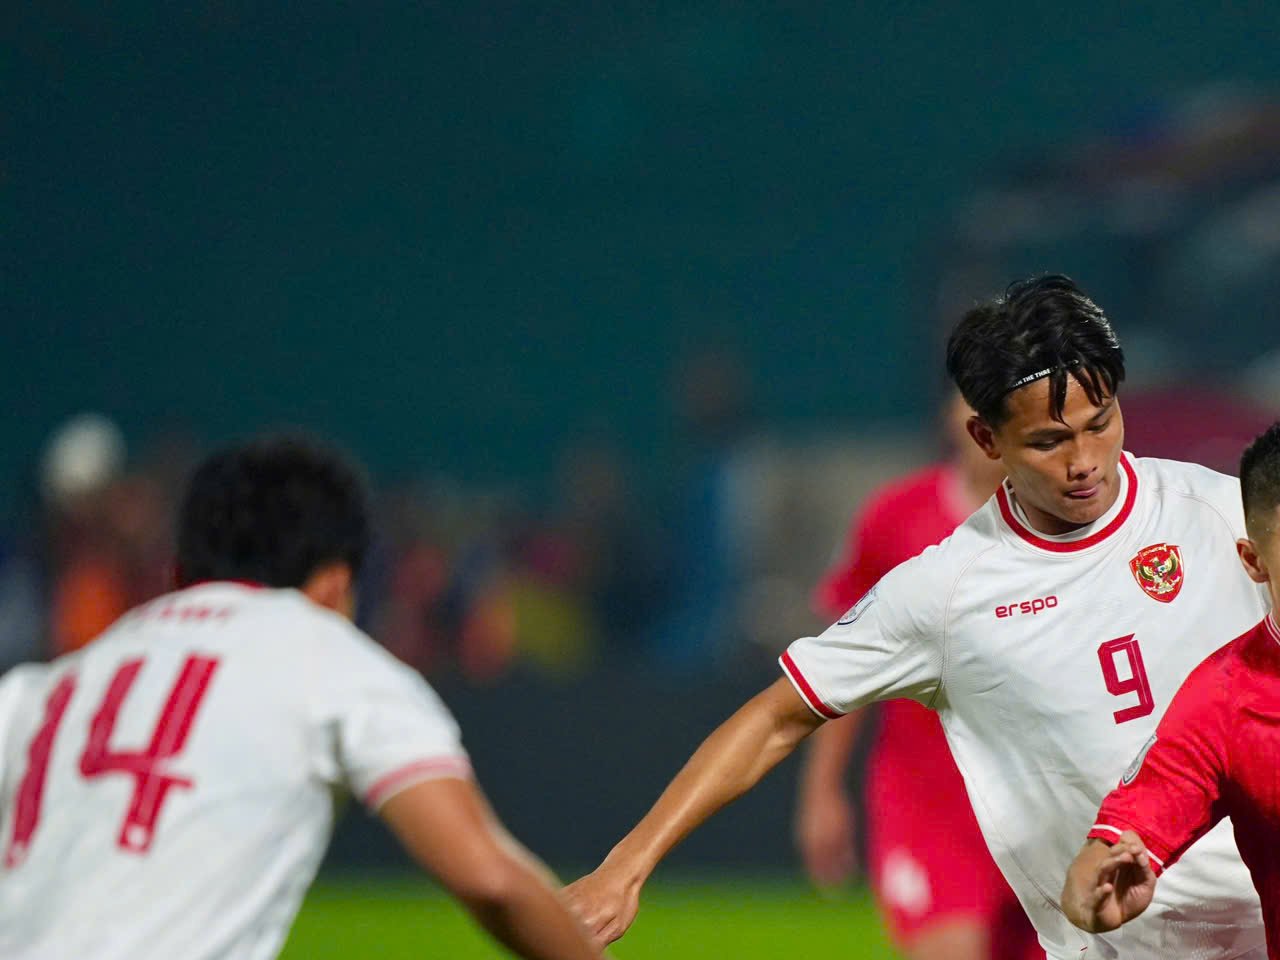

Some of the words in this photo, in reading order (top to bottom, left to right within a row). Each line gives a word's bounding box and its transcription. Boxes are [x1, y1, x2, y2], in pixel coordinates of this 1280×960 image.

[1023, 374, 1034, 383] THE
[1034, 367, 1053, 378] THRE
[995, 596, 1058, 618] erspo
[1097, 633, 1155, 724] 9
[5, 654, 221, 869] 14
